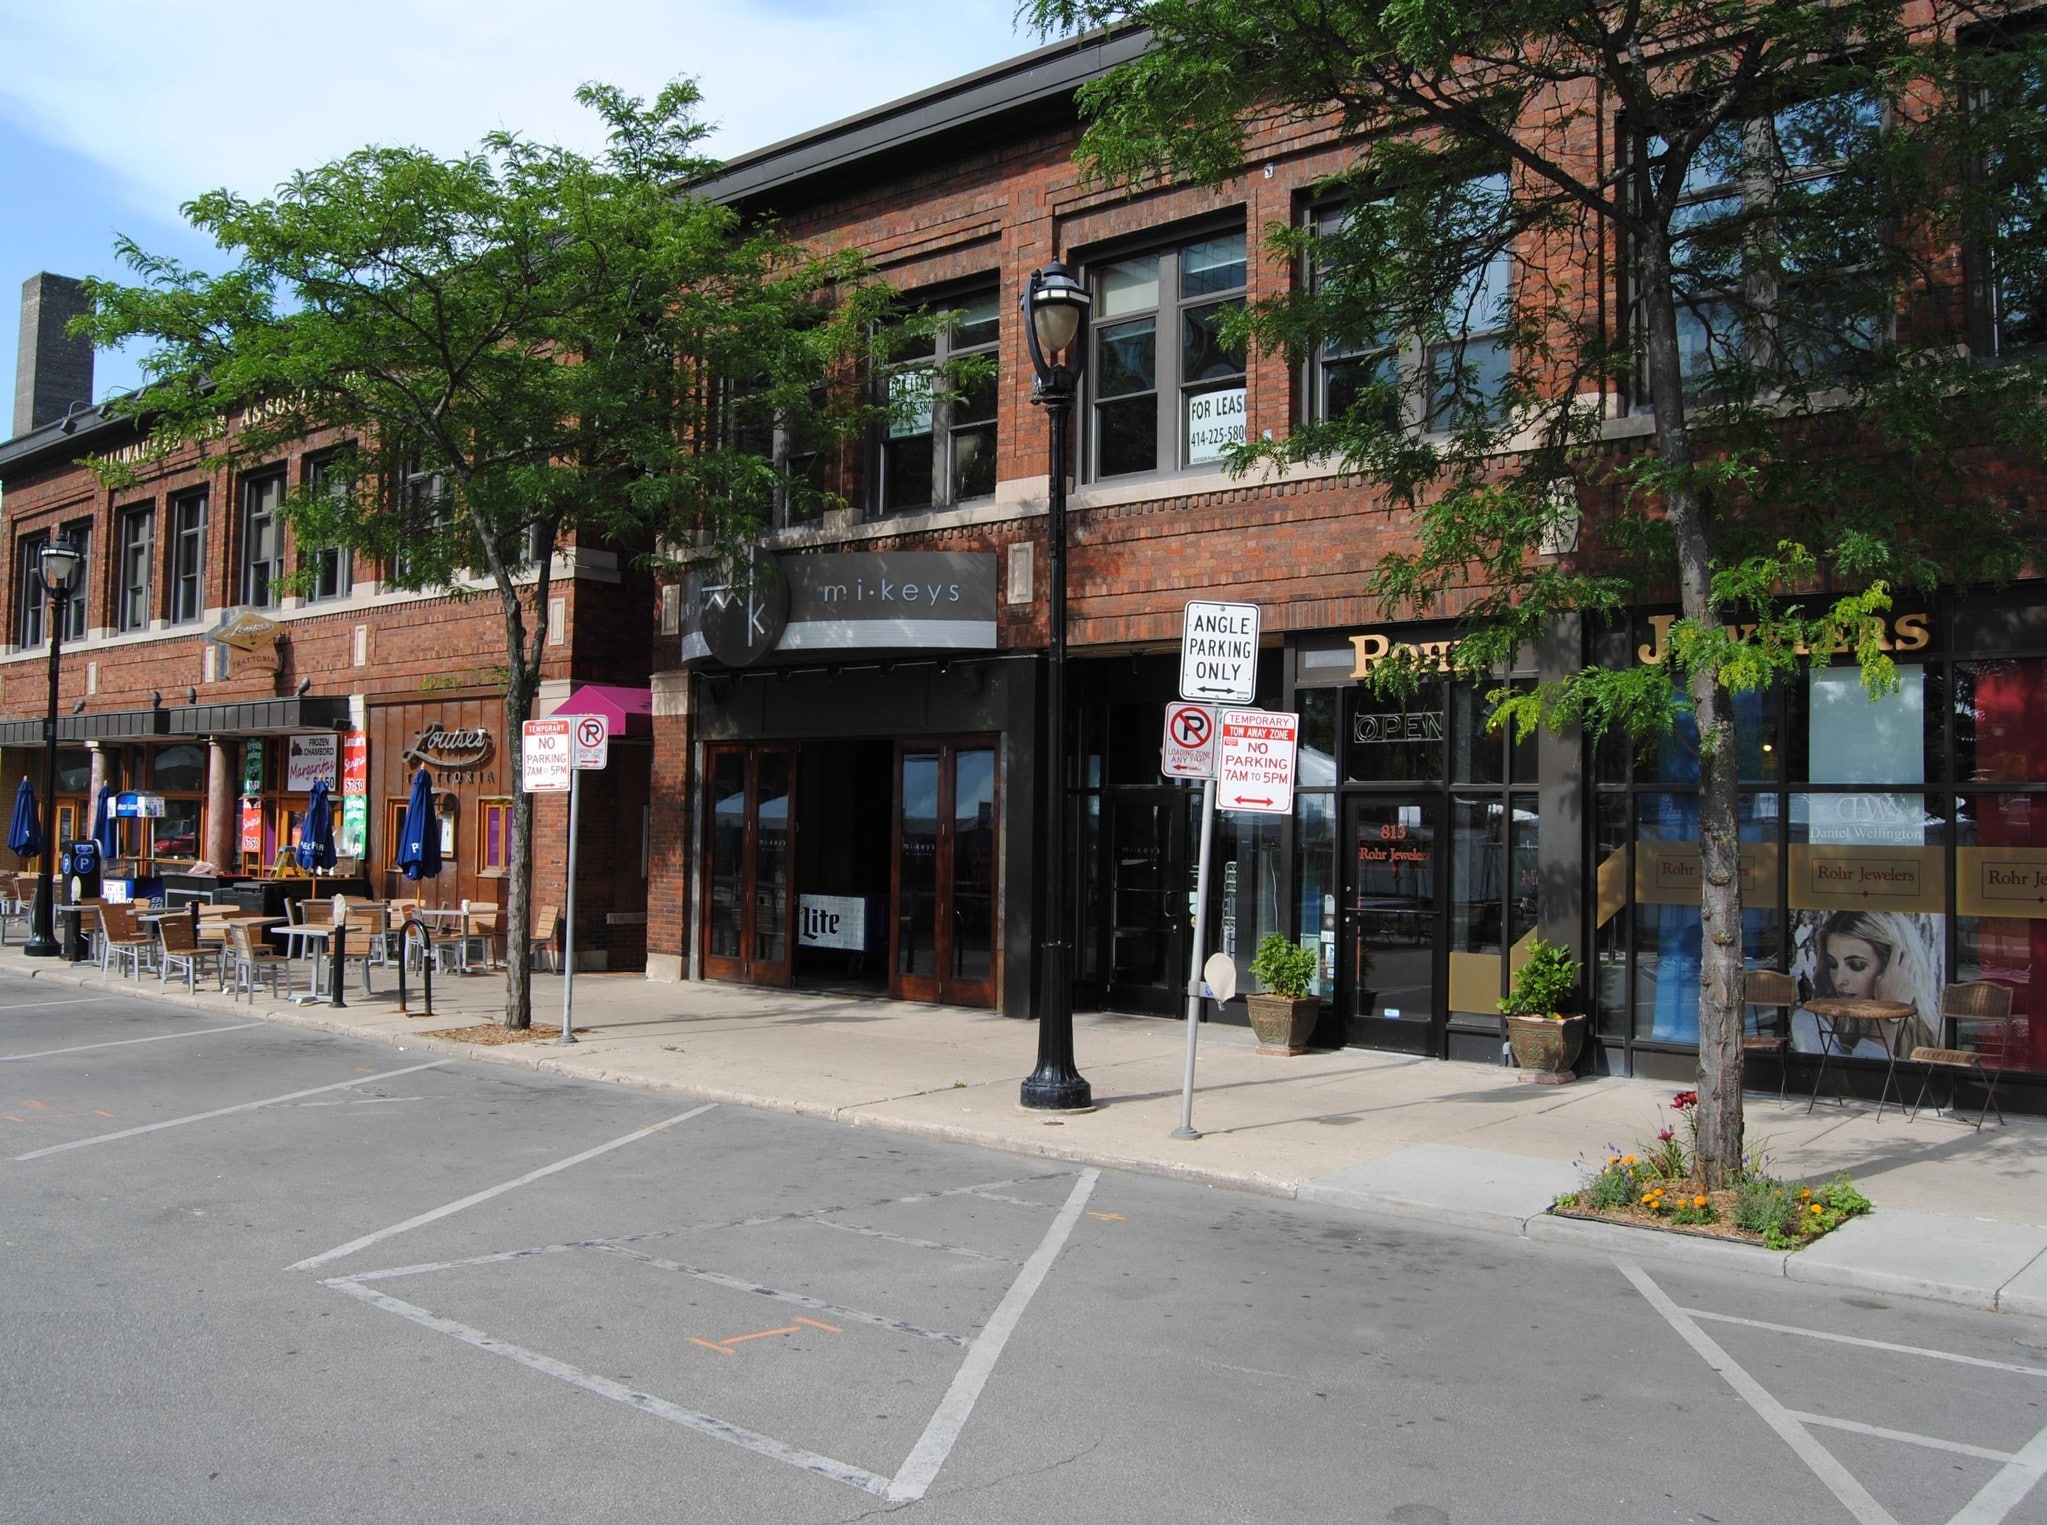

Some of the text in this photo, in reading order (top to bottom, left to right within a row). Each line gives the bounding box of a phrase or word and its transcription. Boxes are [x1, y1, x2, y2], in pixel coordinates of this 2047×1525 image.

[1191, 400, 1211, 421] FOR
[1194, 615, 1250, 634] ANGLE
[1189, 638, 1251, 659] PARKING
[1196, 662, 1241, 681] ONLY
[1229, 714, 1289, 727] TEMPORARY
[1354, 713, 1443, 742] OPEN
[528, 725, 565, 733] TEMPORARY
[1229, 727, 1289, 739] TOW AWAY ZONE
[309, 737, 330, 747] FROZEN
[538, 737, 556, 750] NO
[1247, 742, 1268, 755] NO
[304, 747, 334, 756] CHAMBORD
[1168, 748, 1211, 759] LOADING ZONE
[526, 754, 567, 764] PARKING
[1171, 755, 1188, 763] ANY
[1225, 755, 1288, 769] PARKING
[290, 758, 335, 780] Margaritas
[527, 766, 543, 776] 7AM
[550, 766, 567, 776] 5PM
[1224, 769, 1288, 784] 7AM TO 5PM
[1381, 824, 1407, 839] 813
[1810, 827, 1922, 841] Daniel Wellington
[1359, 847, 1387, 860] Rohr
[1662, 862, 1695, 876] Rohr
[1817, 866, 1915, 883] Rohr Jewelers
[1988, 870, 2028, 885] Rohr
[802, 907, 840, 940] Lite
